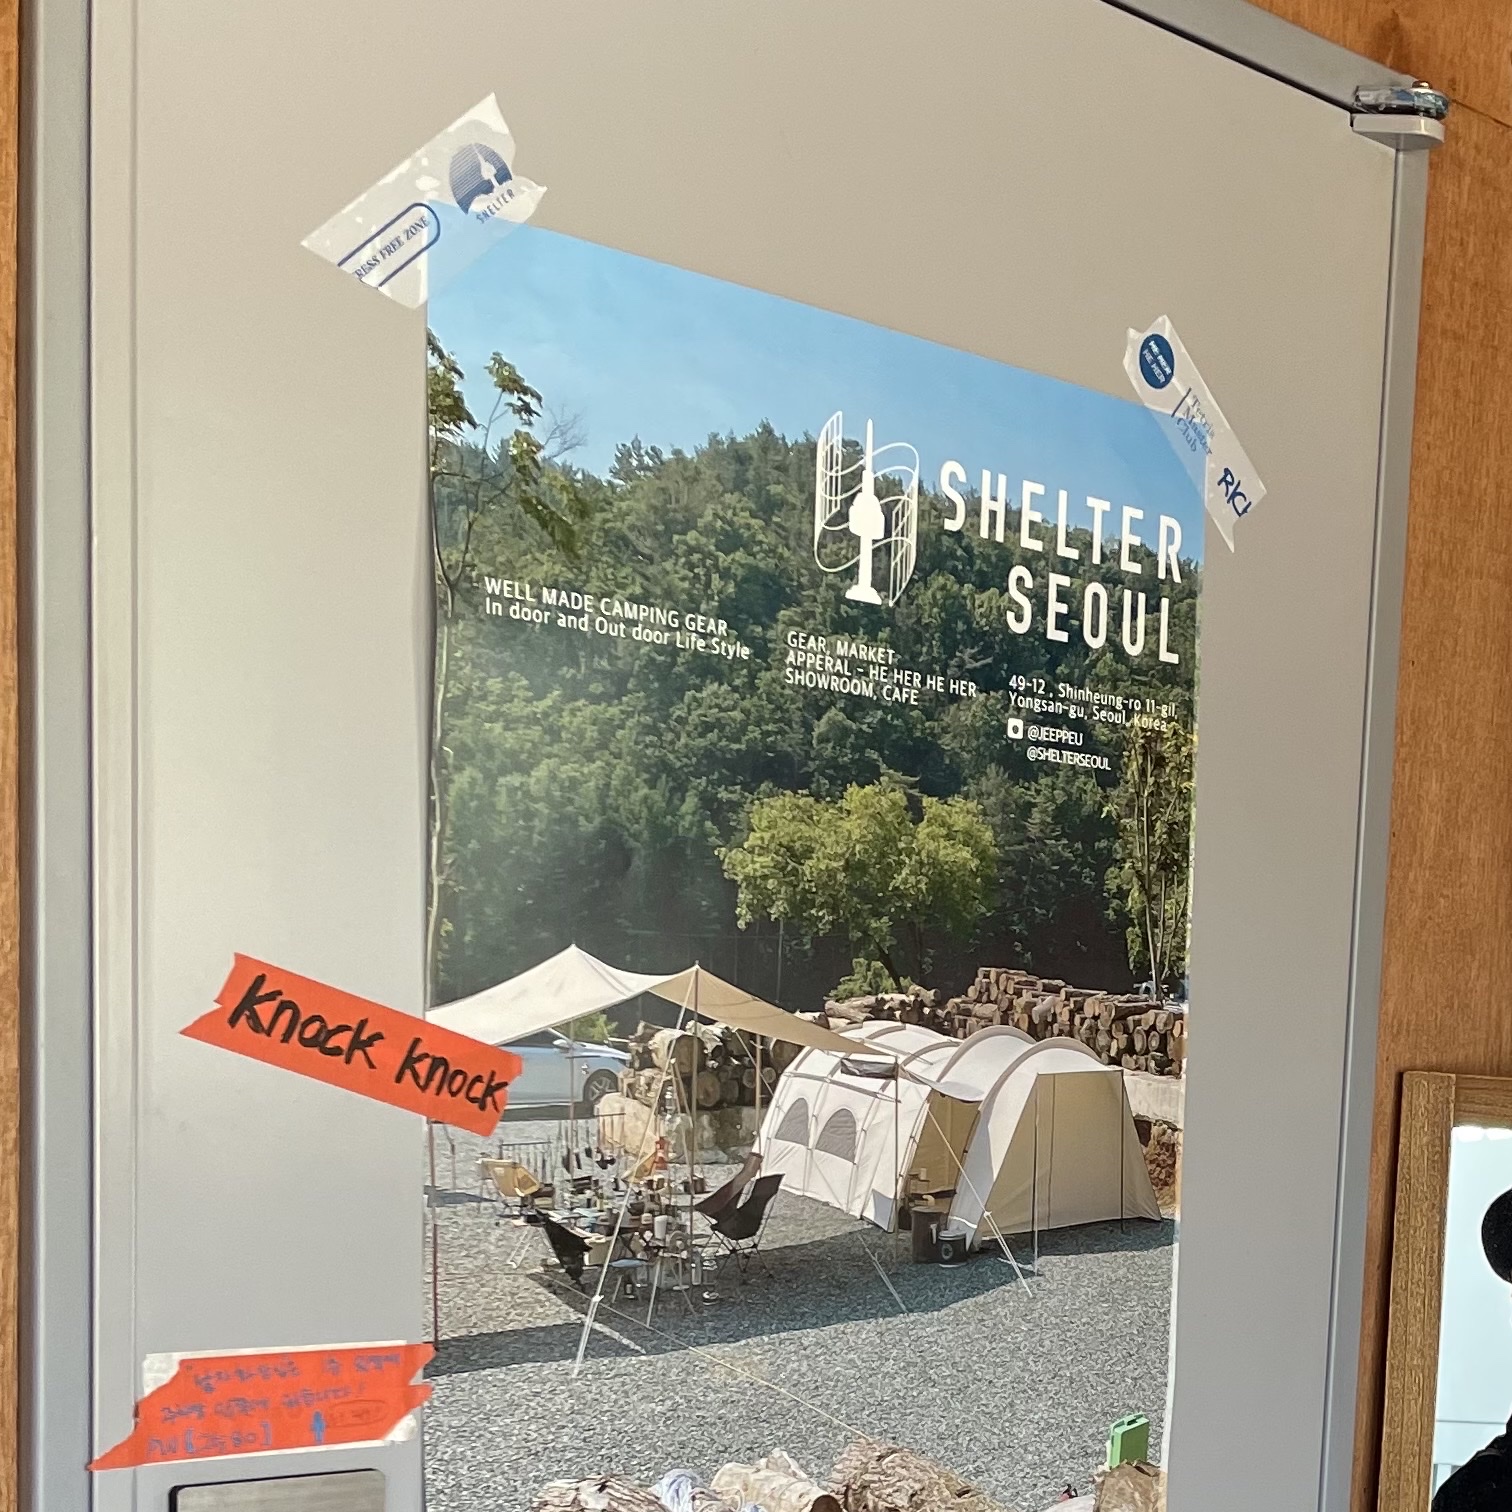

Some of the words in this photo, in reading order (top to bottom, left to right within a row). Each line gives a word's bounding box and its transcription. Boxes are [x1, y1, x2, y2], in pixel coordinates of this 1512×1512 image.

[475, 187, 515, 225] SHELTER
[403, 214, 431, 243] ZONE
[1177, 418, 1197, 452] Club
[940, 460, 1184, 584] SHELTER
[484, 576, 536, 602] WELL
[542, 586, 594, 613] MADE
[600, 597, 679, 628] CAMPING
[685, 613, 728, 637] GEAR
[1006, 564, 1180, 665] SEOUL
[485, 597, 502, 616] In
[509, 602, 551, 624] door
[557, 612, 589, 632] and
[595, 616, 626, 638] Out
[632, 623, 671, 646] door
[675, 630, 706, 652] Life
[711, 637, 750, 660] Style
[787, 630, 831, 654] GEAR,
[836, 640, 895, 665] MARKET
[785, 651, 852, 676] APPERAL
[869, 664, 888, 682] HE
[893, 669, 922, 689] HER
[926, 674, 945, 692] HE
[949, 679, 977, 698] HER
[785, 667, 878, 700] SHOWROOM,
[883, 685, 919, 705] CAFE
[1008, 674, 1046, 695] 49-12
[1058, 683, 1141, 711] Shinheung-ro
[1008, 691, 1088, 720] Yongsan-gu,
[1133, 713, 1168, 731] Korea
[1027, 725, 1084, 746] @JEEPPEU
[1027, 745, 1112, 771] @SHELTERSEOUL
